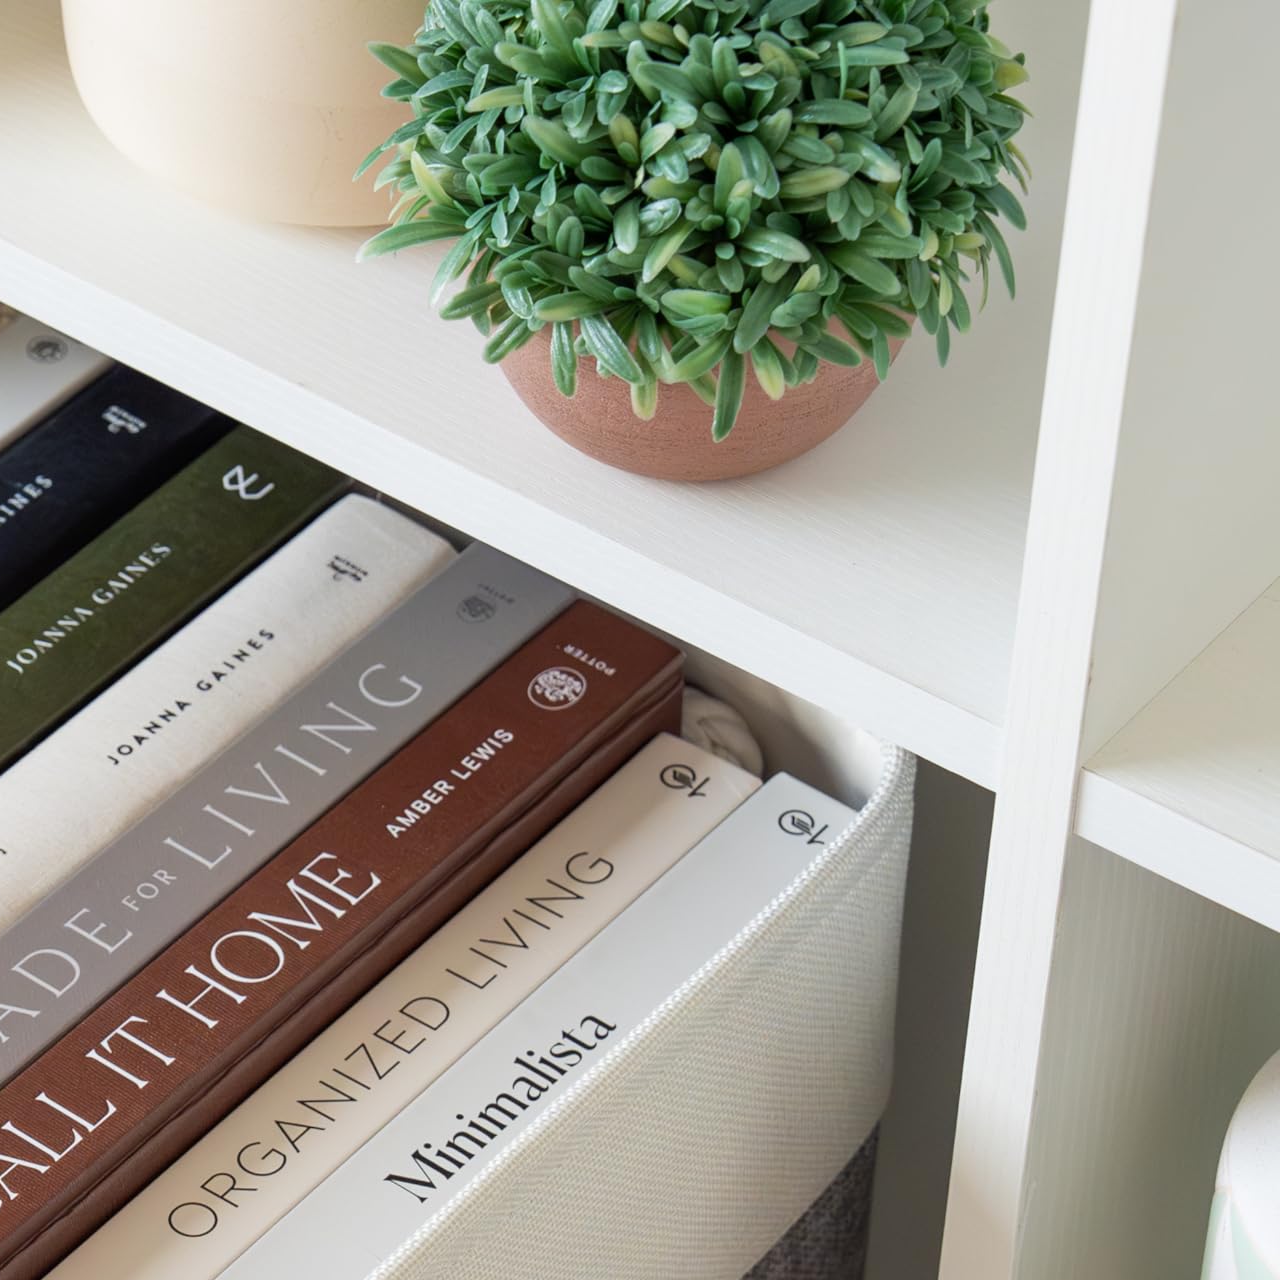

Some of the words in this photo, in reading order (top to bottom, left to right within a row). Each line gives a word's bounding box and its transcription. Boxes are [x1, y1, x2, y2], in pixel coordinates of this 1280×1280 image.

[6, 607, 93, 674] JOANNA
[91, 542, 173, 606] GAINES
[107, 698, 191, 766] JOANNA
[196, 628, 275, 692] GAINES
[122, 869, 177, 912] FOR
[163, 664, 422, 870] LIVING
[85, 1016, 175, 1089] IT
[156, 853, 382, 1029] HOME
[386, 780, 455, 839] AMBER
[450, 729, 514, 780] LEWIS
[168, 995, 450, 1240] ORGANIZED
[447, 851, 615, 989] LIVING
[383, 1010, 617, 1205] Minimalista
